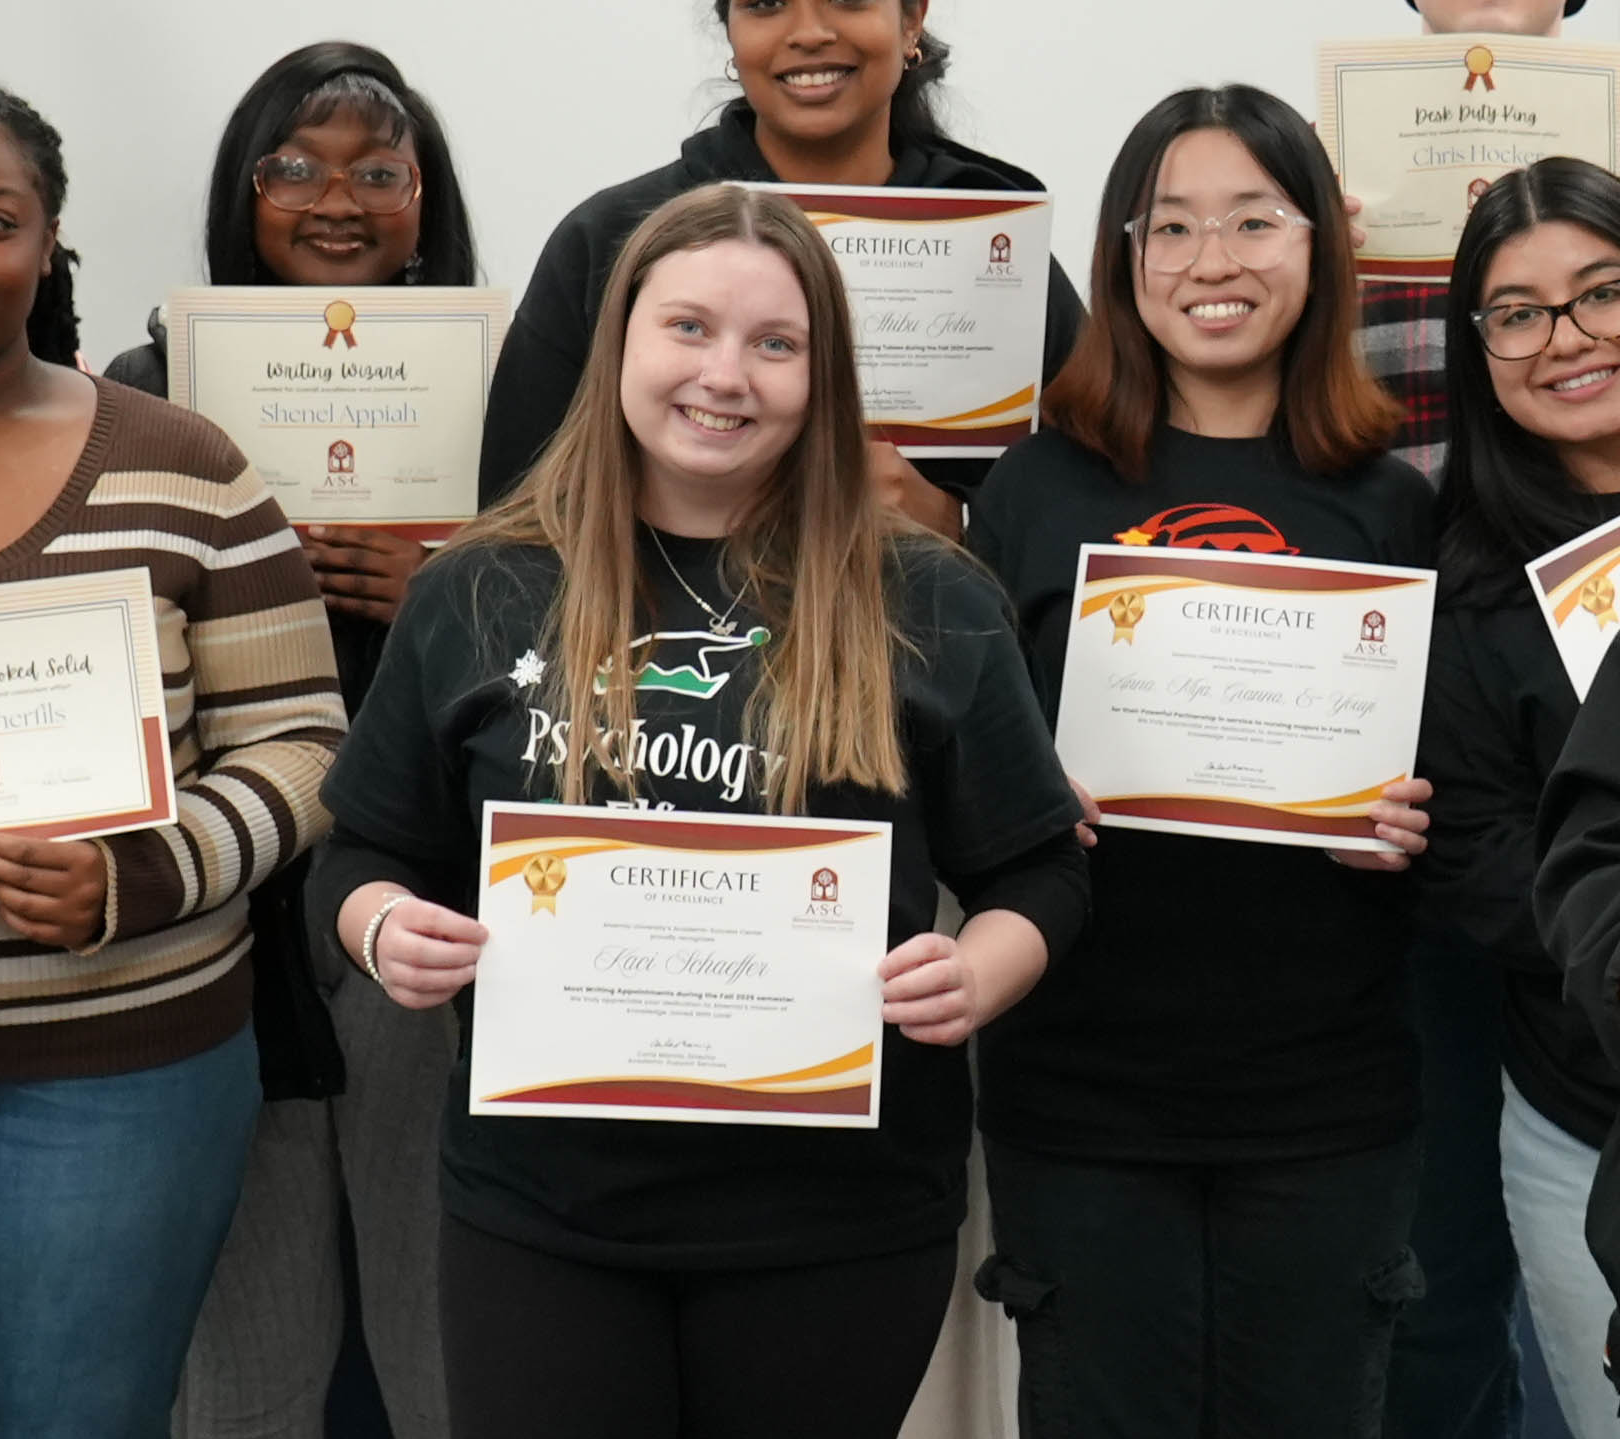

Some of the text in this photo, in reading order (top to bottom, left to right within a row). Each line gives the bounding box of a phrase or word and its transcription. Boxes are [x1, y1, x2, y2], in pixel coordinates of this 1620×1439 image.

[1415, 104, 1537, 126] Desk Duty King
[1413, 145, 1465, 166] Chris
[831, 237, 952, 257] CERTIFICATE
[267, 361, 407, 382] Writing Wizard
[260, 403, 418, 429] Shenel Appiah
[1182, 600, 1316, 630] CERTIFICATE
[44, 654, 93, 676] Solid
[610, 866, 761, 893] CERTIFICATE
[644, 893, 724, 905] OF EXCELLENCE
[594, 945, 771, 985] Kaci Schaeffer
